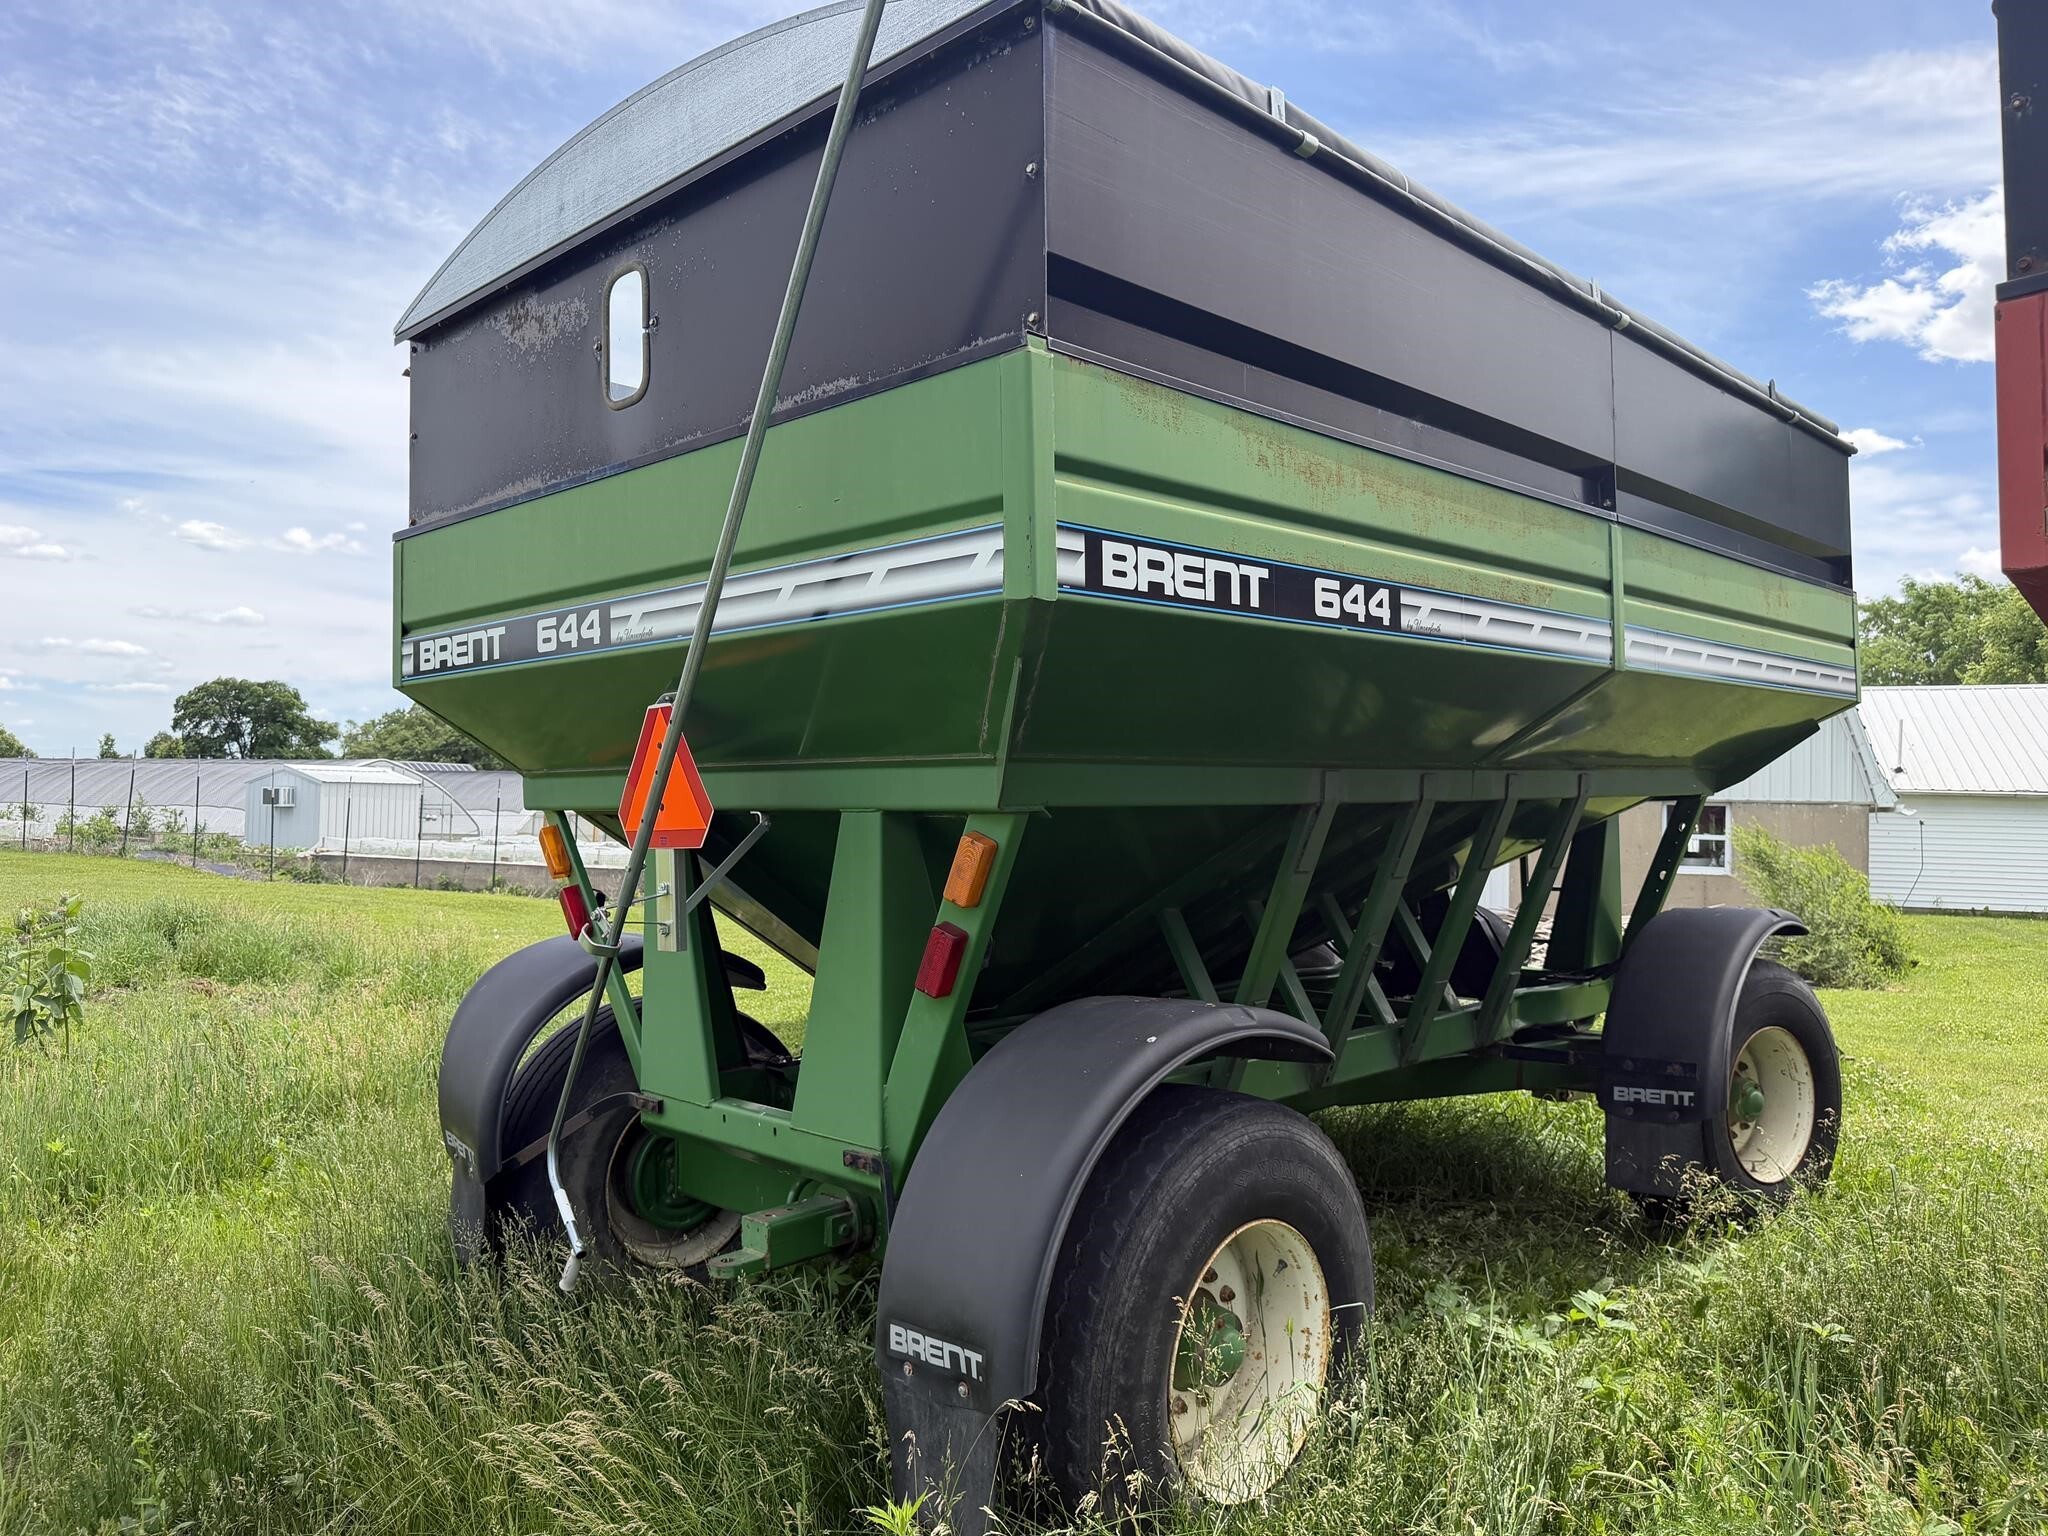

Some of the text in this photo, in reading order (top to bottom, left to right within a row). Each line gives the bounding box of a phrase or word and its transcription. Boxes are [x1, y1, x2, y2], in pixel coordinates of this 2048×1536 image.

[1101, 539, 1391, 626] BRENT 644
[419, 608, 601, 671] BRENT 644
